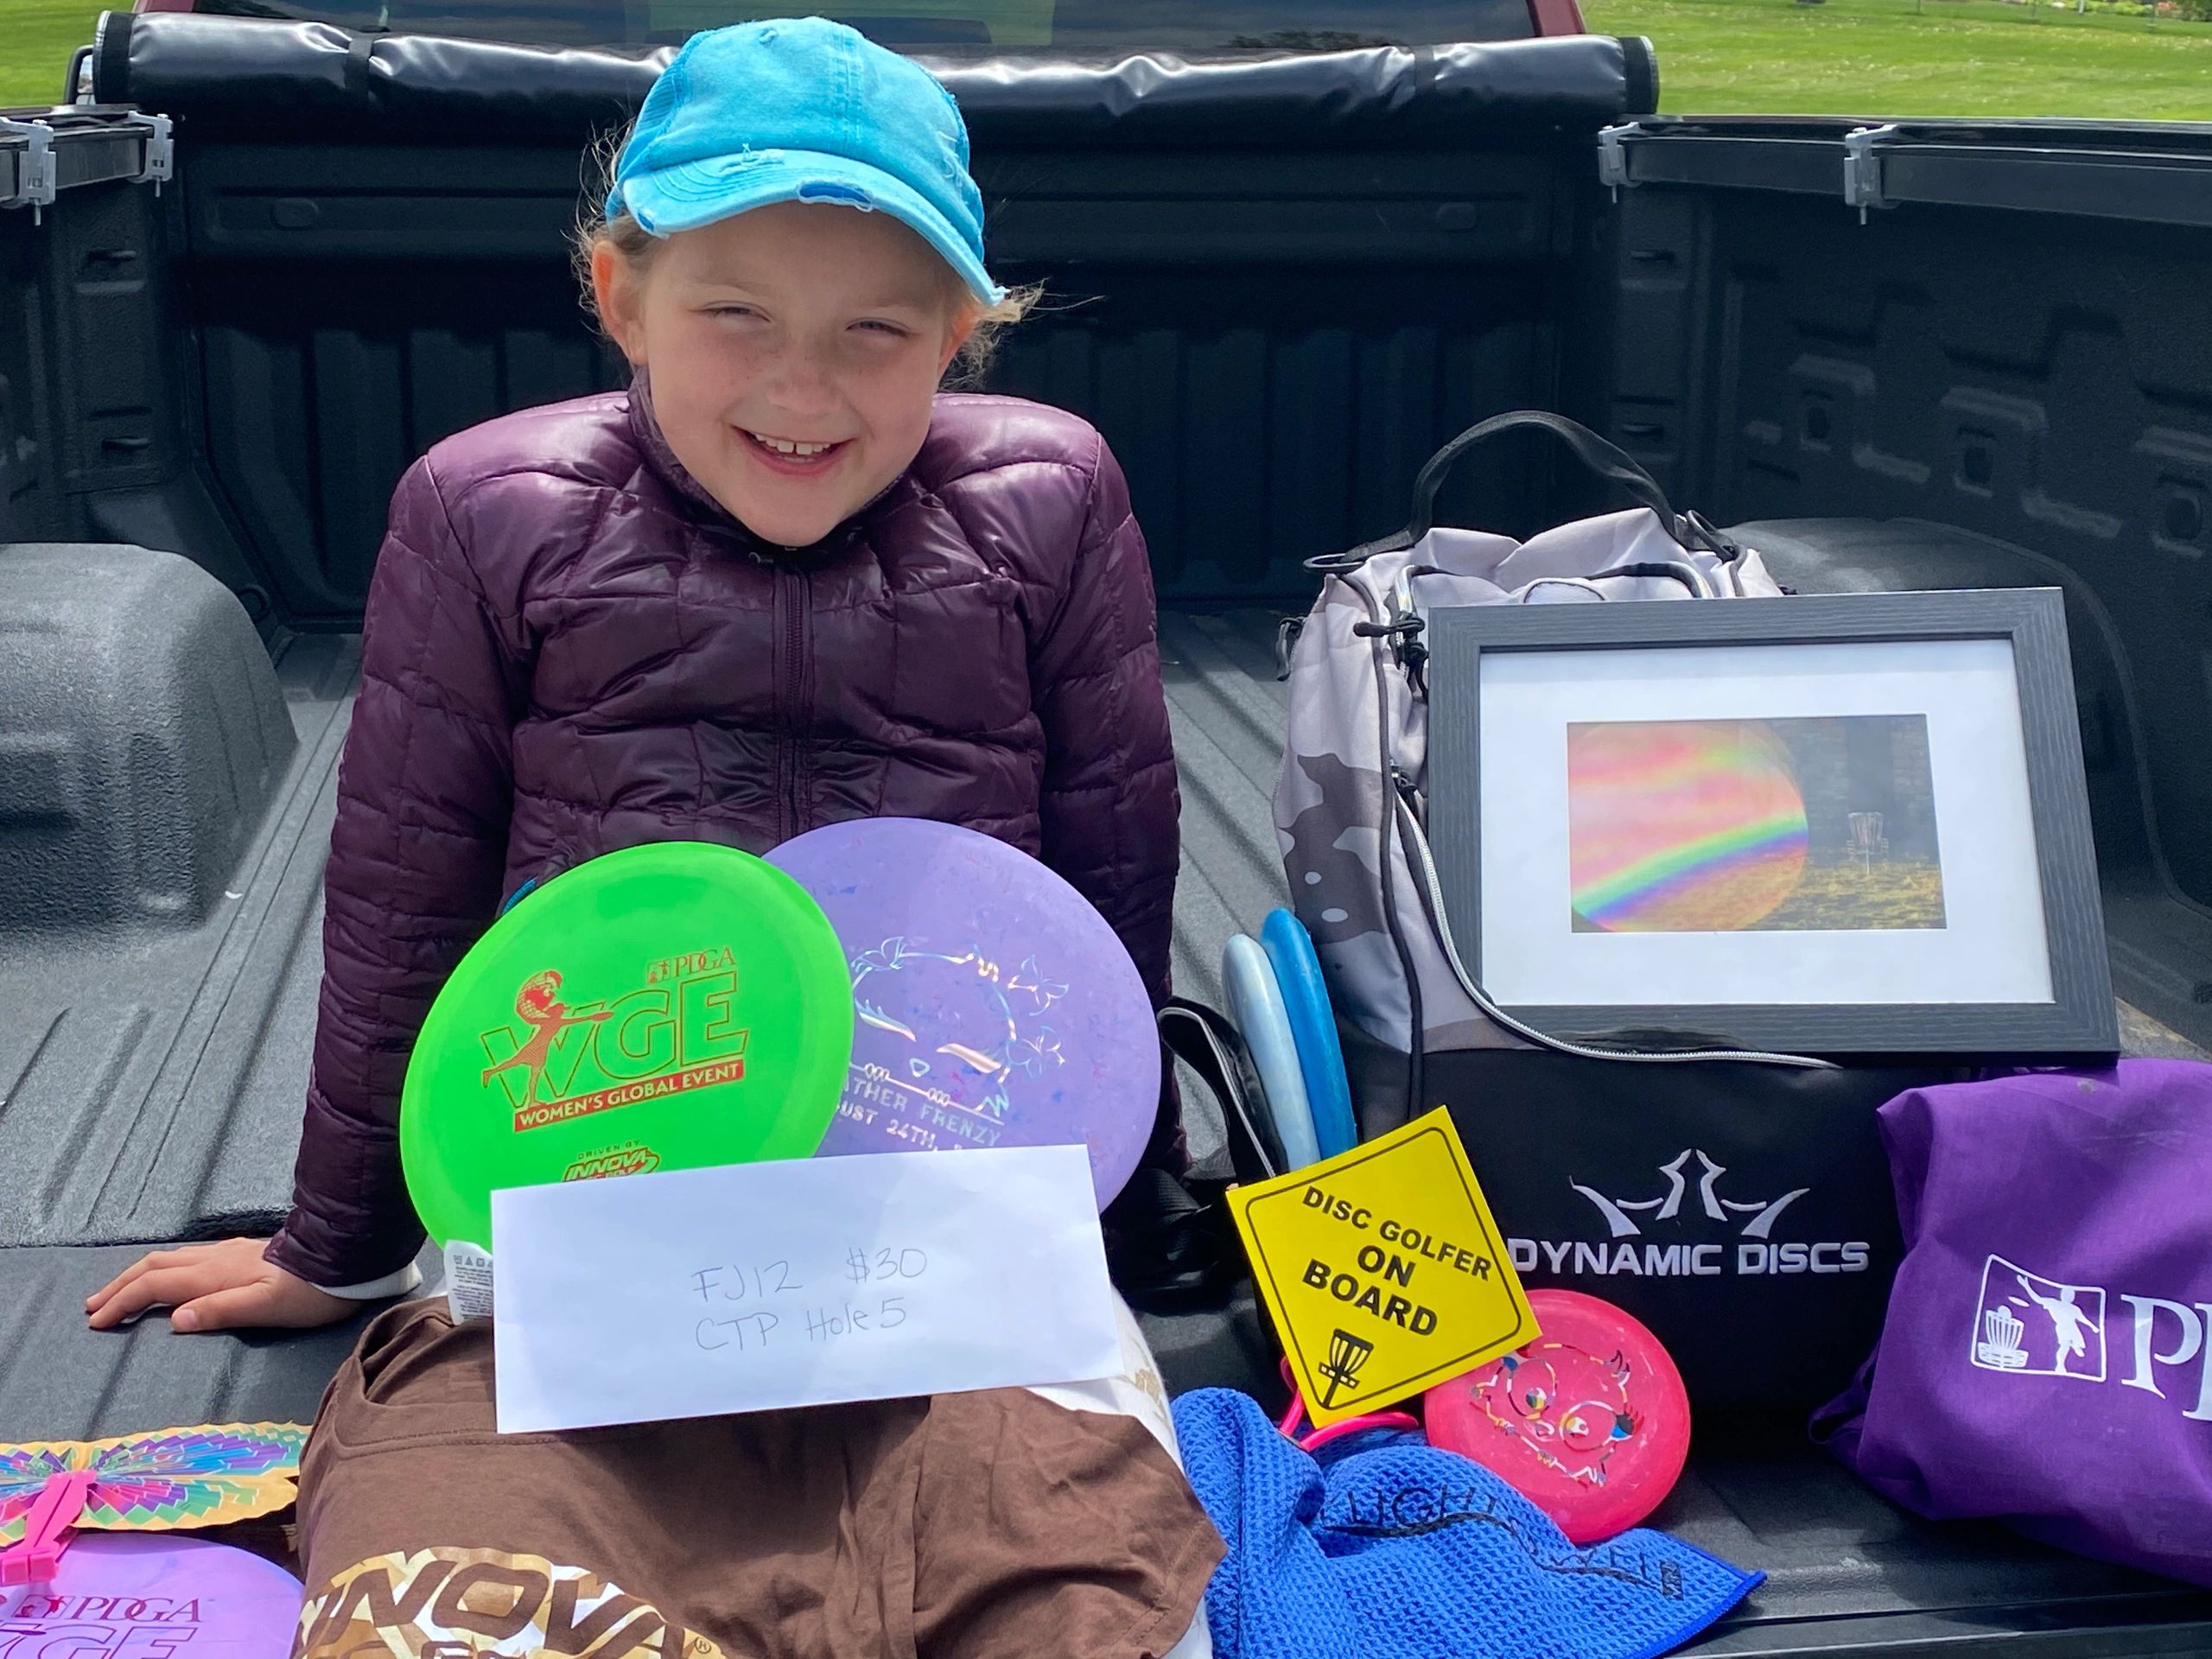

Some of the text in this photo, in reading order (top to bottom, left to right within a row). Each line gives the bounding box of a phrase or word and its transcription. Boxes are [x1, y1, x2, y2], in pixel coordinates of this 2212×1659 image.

[673, 946, 736, 977] PDGA
[519, 1063, 740, 1127] WOMEN'S GLOBAL EVENT
[836, 1099, 879, 1125] UST
[843, 1070, 1001, 1147] THER FRENZY
[563, 1147, 654, 1181] INNOVA
[577, 1139, 640, 1160] DRIVEN BY
[1302, 1185, 1492, 1281] DISC GOLFER
[691, 1247, 927, 1302] FJ12 $30
[1357, 1244, 1416, 1287] ON
[1507, 1237, 1871, 1276] DYNAMIC DISCS
[1302, 1258, 1438, 1337] BOARD
[696, 1297, 906, 1351] CTP Hole 5
[64, 1596, 201, 1623] PDGA
